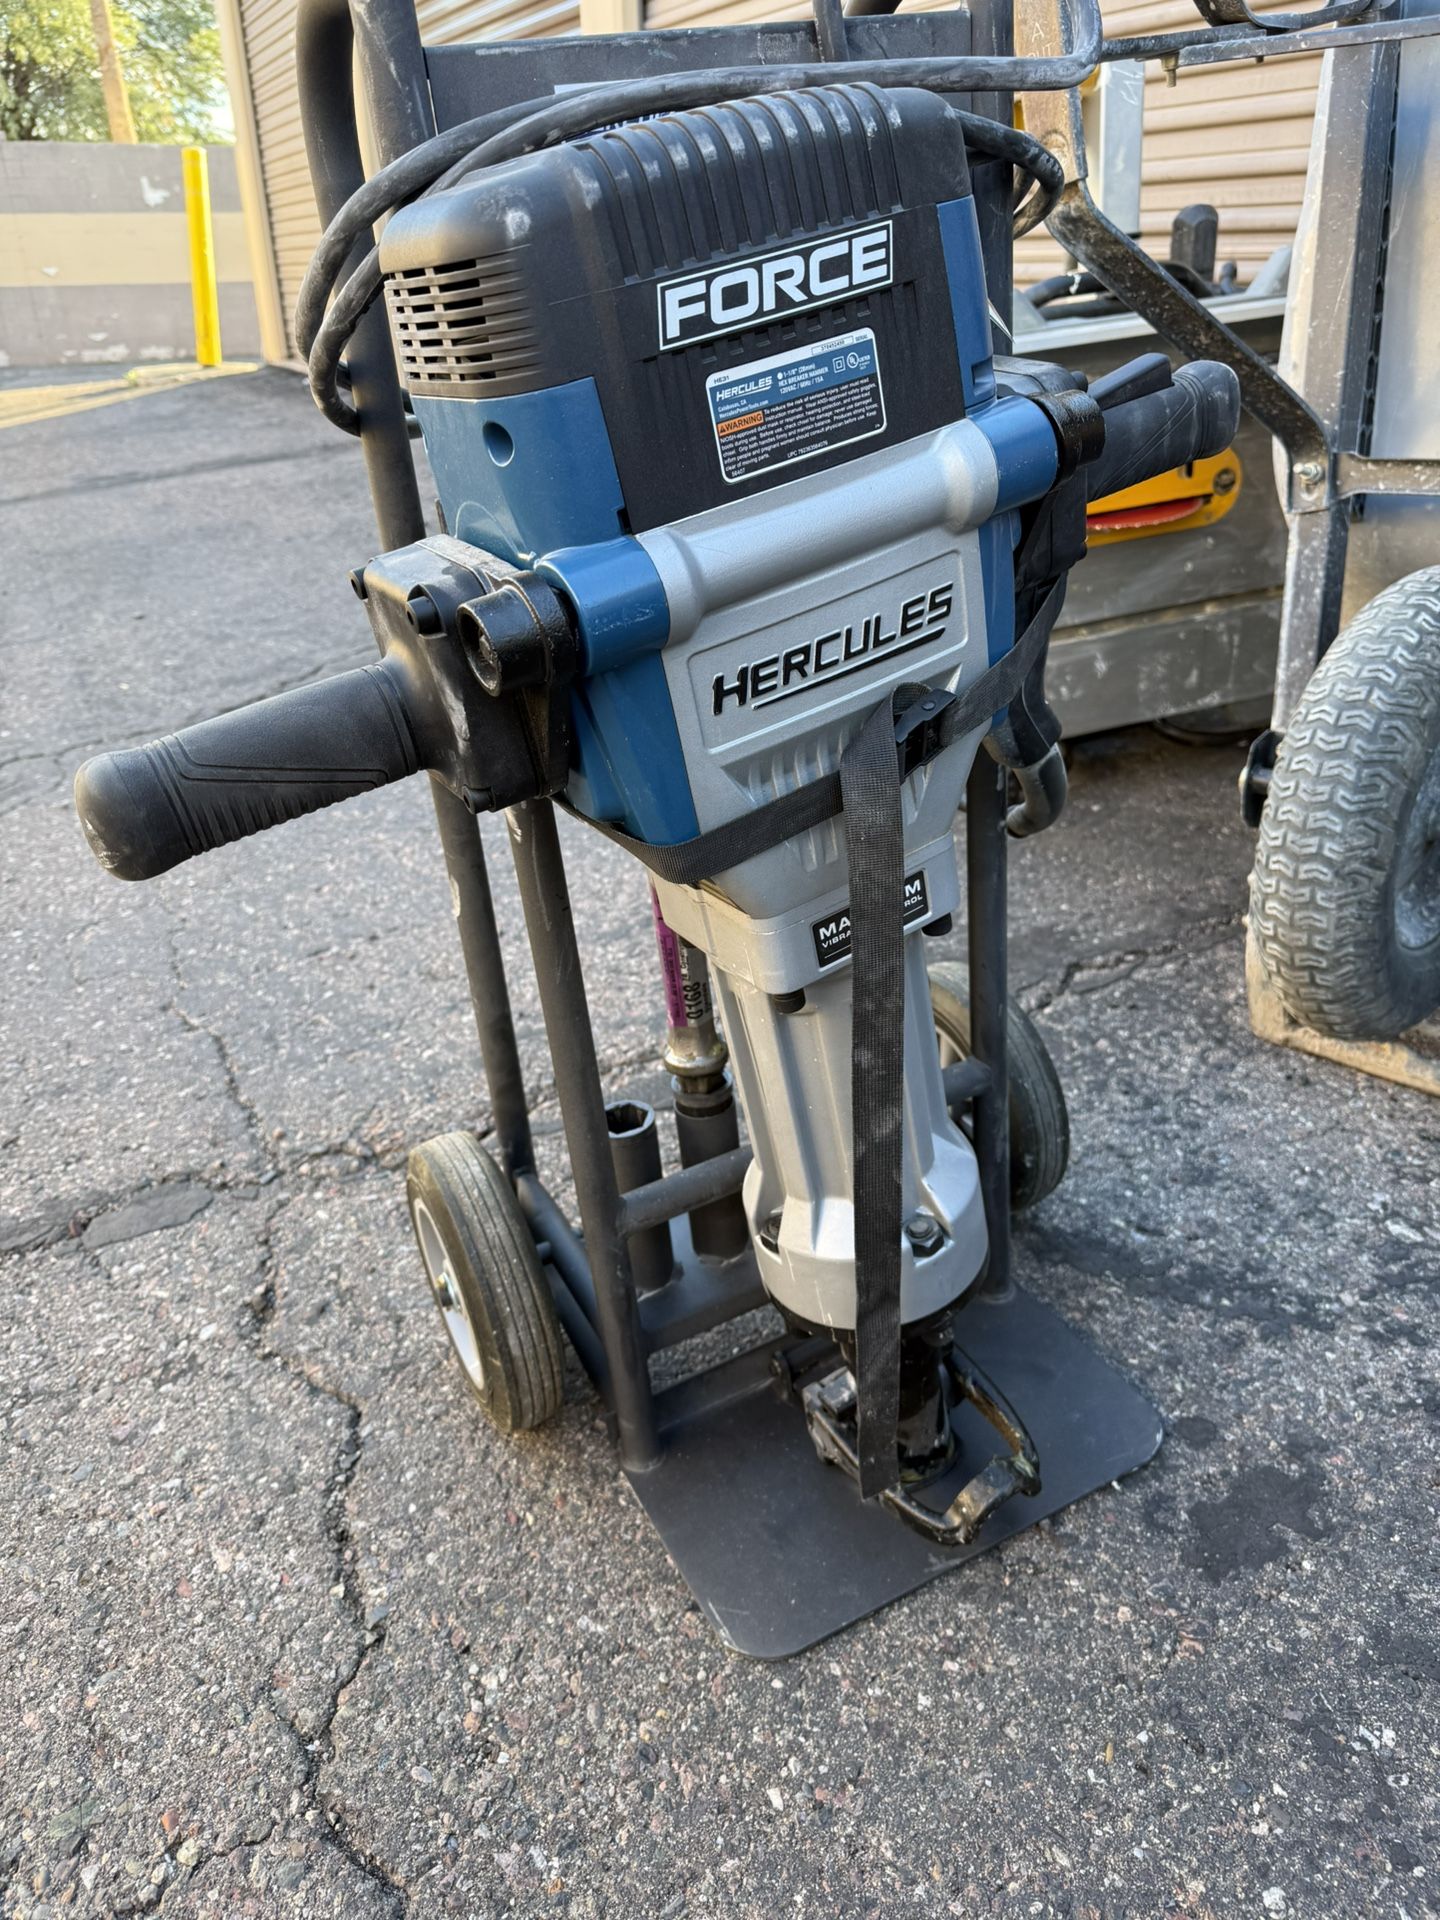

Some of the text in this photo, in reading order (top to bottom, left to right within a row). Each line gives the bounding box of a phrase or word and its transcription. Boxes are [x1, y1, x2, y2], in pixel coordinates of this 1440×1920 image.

[665, 230, 887, 339] FORCE
[714, 376, 729, 384] HE31
[788, 373, 808, 384] BREAKER
[809, 367, 828, 377] HAMMER
[717, 376, 772, 401] HERCULES
[810, 392, 825, 400] serious
[760, 430, 773, 438] Before
[854, 398, 872, 407] damaged
[765, 412, 786, 421] instruction
[818, 392, 847, 404] ANSI-approved
[725, 414, 762, 431] WARNING
[759, 437, 775, 445] handles
[834, 412, 852, 420] Produces
[720, 428, 756, 443] NIOSH-approved
[737, 452, 751, 460] people
[761, 442, 779, 452] pregnant
[796, 432, 809, 440] should
[810, 428, 824, 436] consult
[826, 422, 843, 431] physician
[788, 450, 797, 458] UPC
[713, 582, 953, 716] HERCULES
